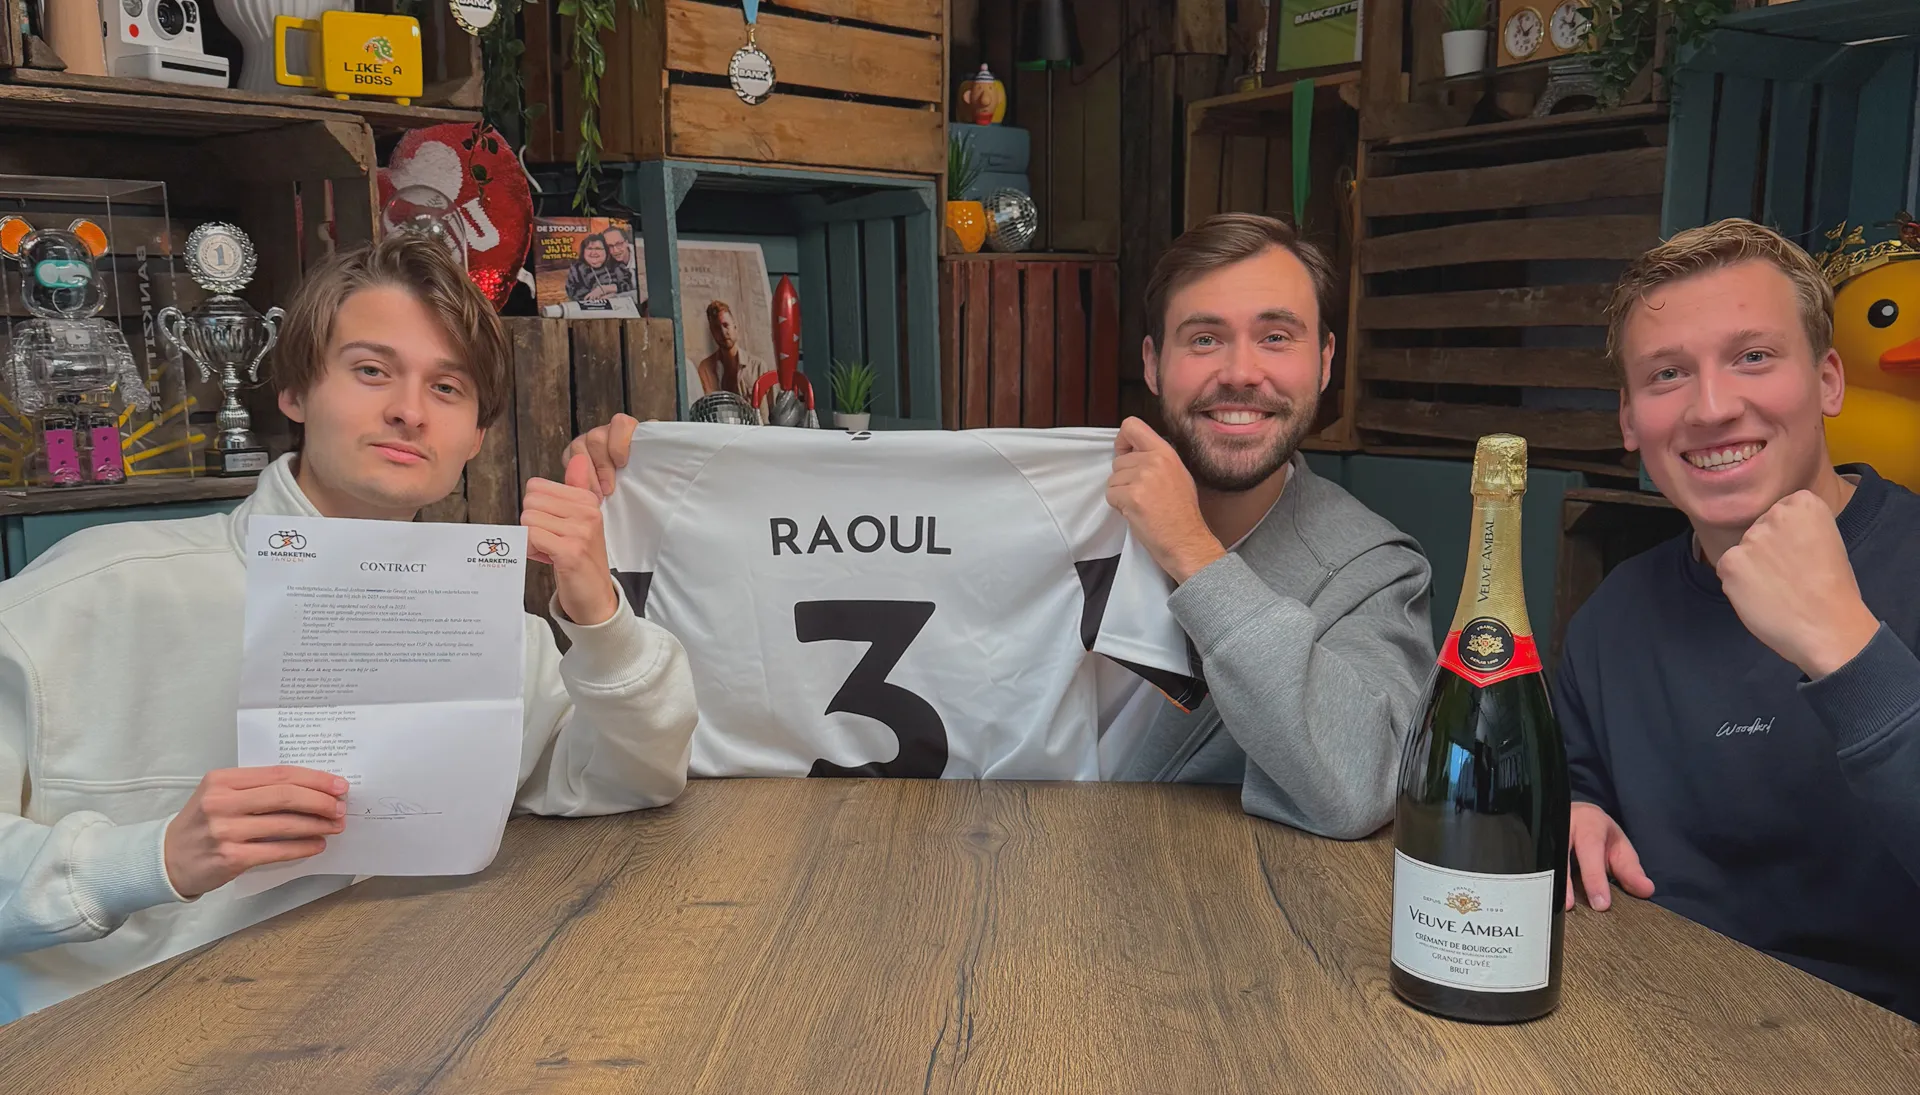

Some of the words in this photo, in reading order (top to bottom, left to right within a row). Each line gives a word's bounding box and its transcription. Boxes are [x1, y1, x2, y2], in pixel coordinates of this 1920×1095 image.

[344, 62, 383, 73] LIKE
[393, 66, 402, 75] A
[354, 74, 393, 86] BOSS
[549, 225, 587, 233] STOOPJES
[214, 245, 228, 266] 1
[770, 515, 951, 555] RAOUL
[1482, 518, 1495, 560] AMBAL
[360, 562, 427, 573] CONTRACT
[1478, 564, 1491, 603] VEUVE
[794, 599, 948, 778] 3
[1423, 896, 1441, 904] DEPUIS
[1409, 905, 1457, 933] VEUVE
[1461, 921, 1524, 937] AMBAL
[1415, 932, 1448, 947] CRÉMANT
[1450, 941, 1460, 950] DE
[1462, 944, 1513, 954] BOURGOGNE
[1432, 952, 1463, 965] GRANDE
[1465, 957, 1490, 968] CUVÉE
[1450, 965, 1470, 975] BRUT
